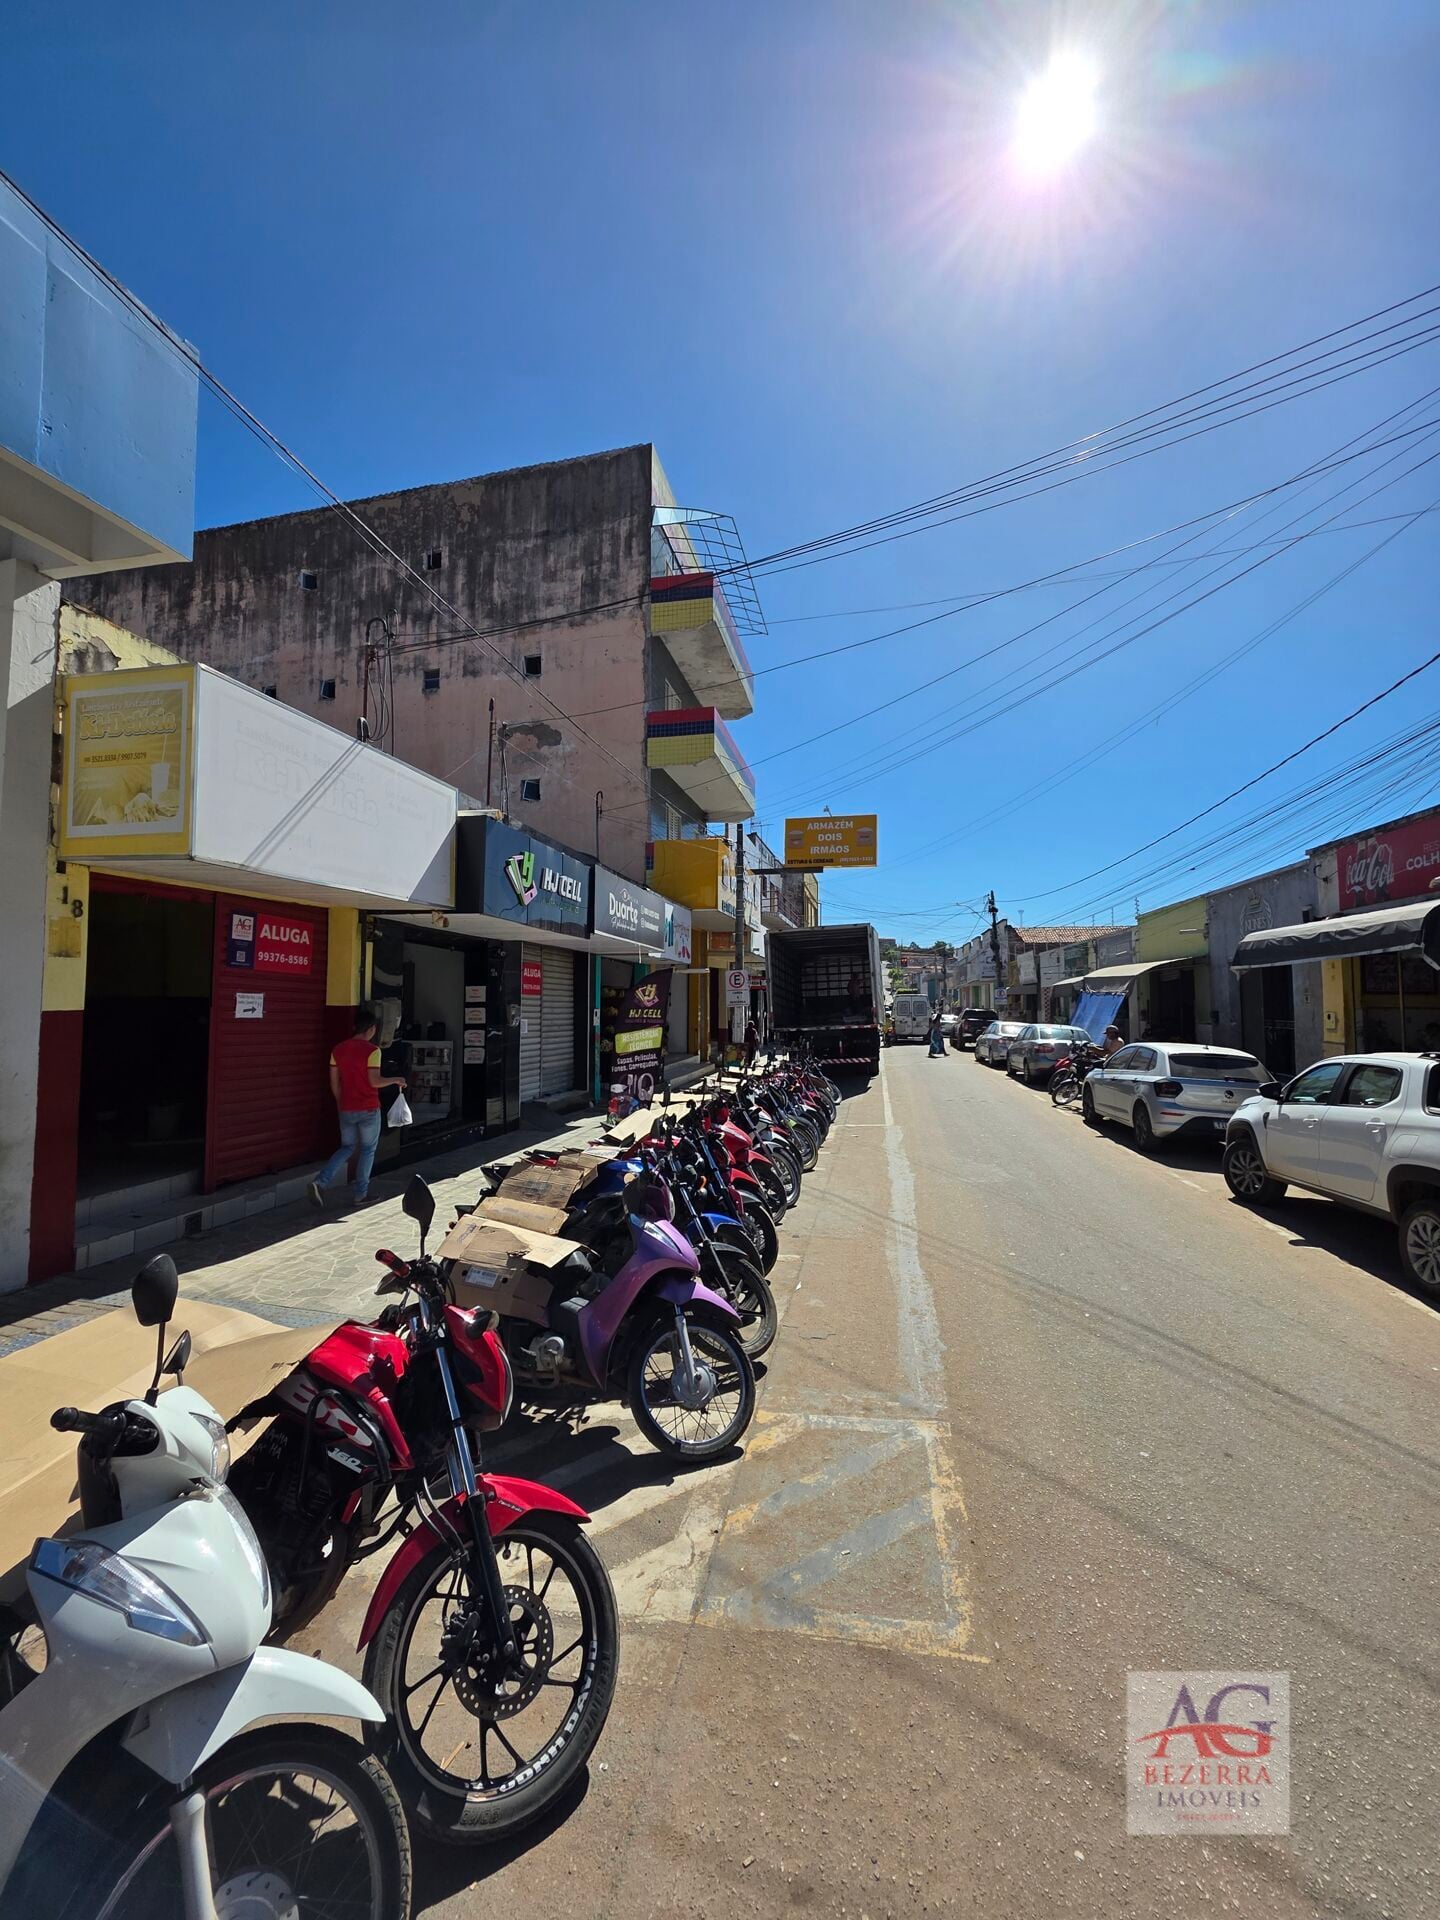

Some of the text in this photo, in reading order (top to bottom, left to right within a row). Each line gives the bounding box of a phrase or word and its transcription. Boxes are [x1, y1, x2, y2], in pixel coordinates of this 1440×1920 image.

[807, 819, 854, 831] ARMAZÉM
[818, 832, 842, 842] DOIS
[542, 867, 582, 903] HJ CELL
[609, 892, 638, 924] Duarte
[260, 924, 310, 945] ALUGA
[258, 951, 309, 966] 99376-8586
[523, 967, 541, 978] ALUGA
[734, 975, 742, 986] E
[629, 1009, 662, 1018] HJ CELL
[328, 1447, 362, 1474] 160
